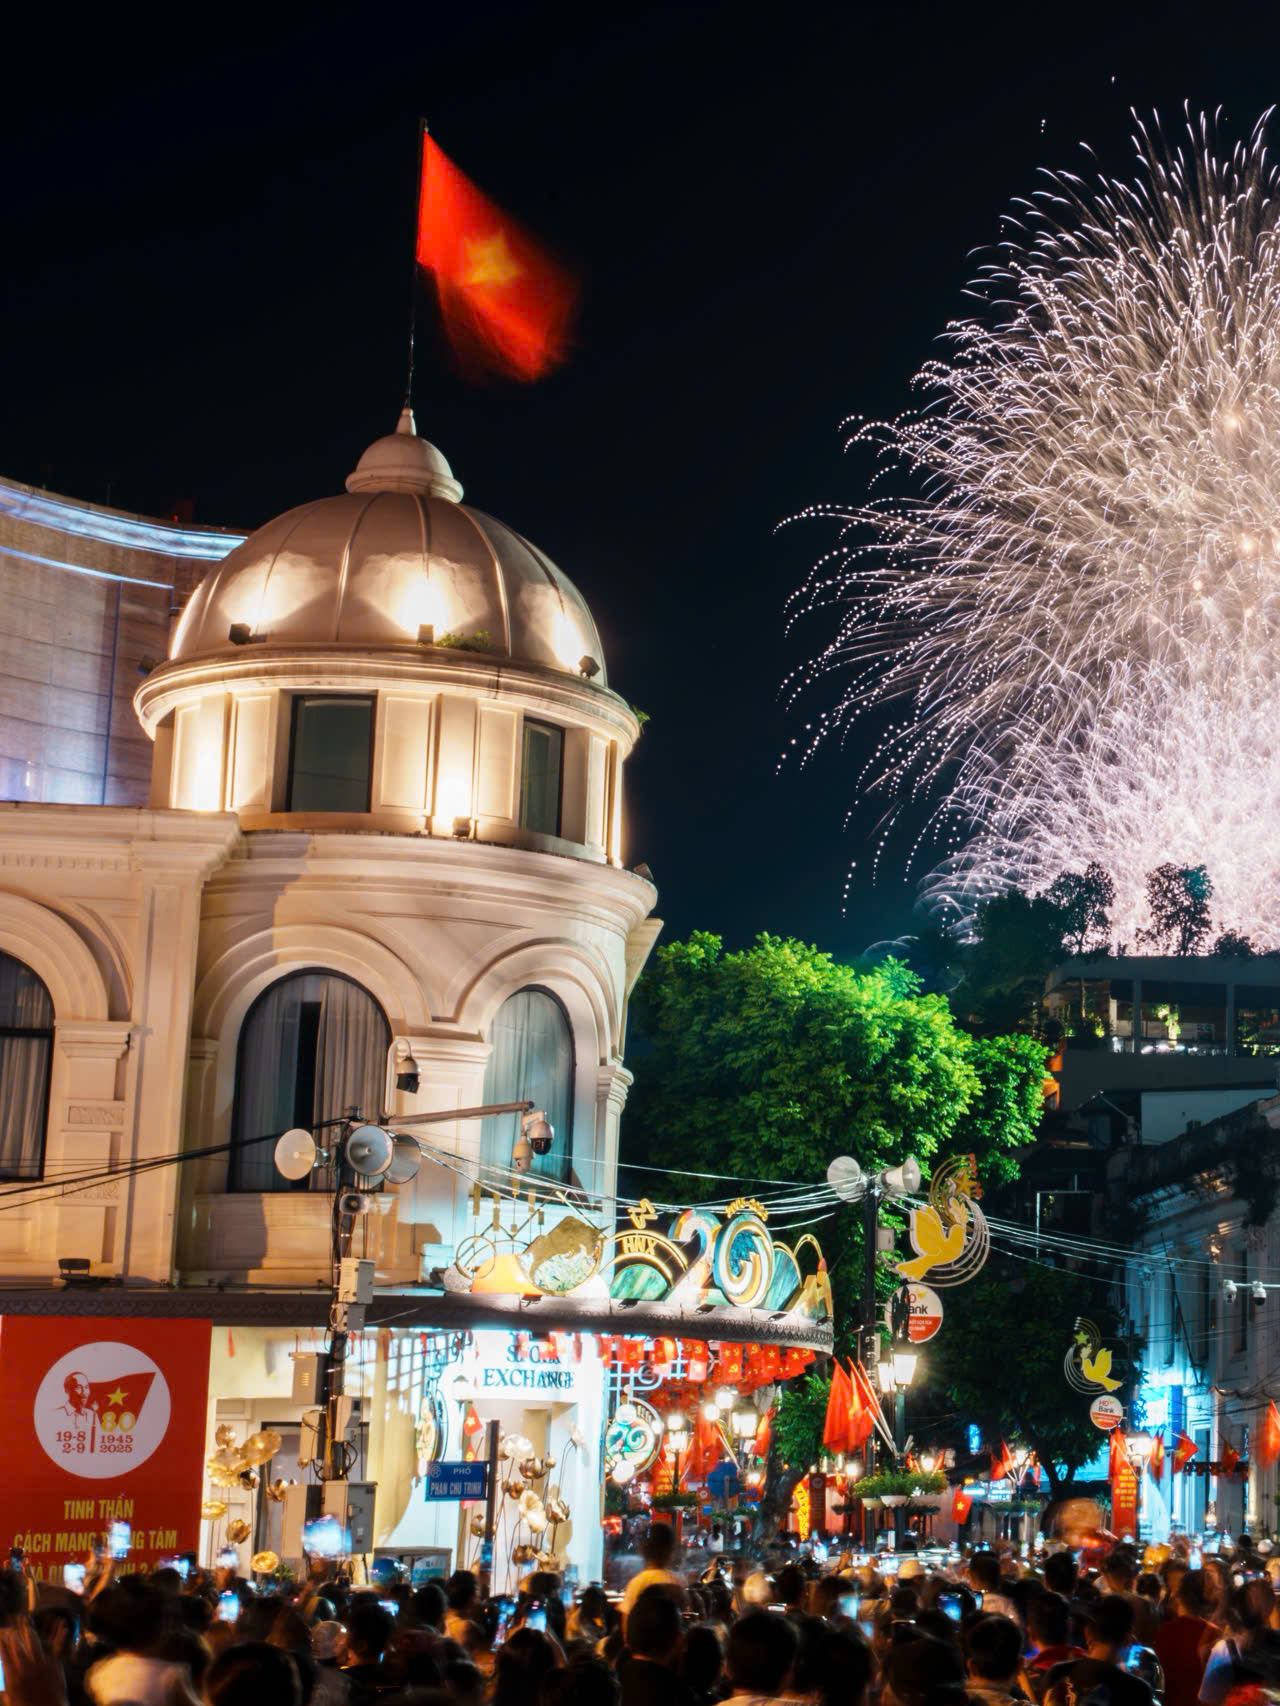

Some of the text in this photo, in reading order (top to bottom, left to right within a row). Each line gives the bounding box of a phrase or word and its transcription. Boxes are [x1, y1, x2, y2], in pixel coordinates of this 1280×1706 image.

[622, 1236, 657, 1256] HNX
[909, 1304, 928, 1314] ank
[483, 1368, 575, 1390] EXCHANGE
[102, 1411, 135, 1432] 80
[56, 1431, 86, 1442] 19-8
[100, 1434, 134, 1444] 1945
[62, 1442, 86, 1454] 2-9
[99, 1444, 133, 1453] 2025
[64, 1500, 95, 1520] TINH
[14, 1530, 51, 1552] CÁCH
[149, 1526, 177, 1550] TÁM
